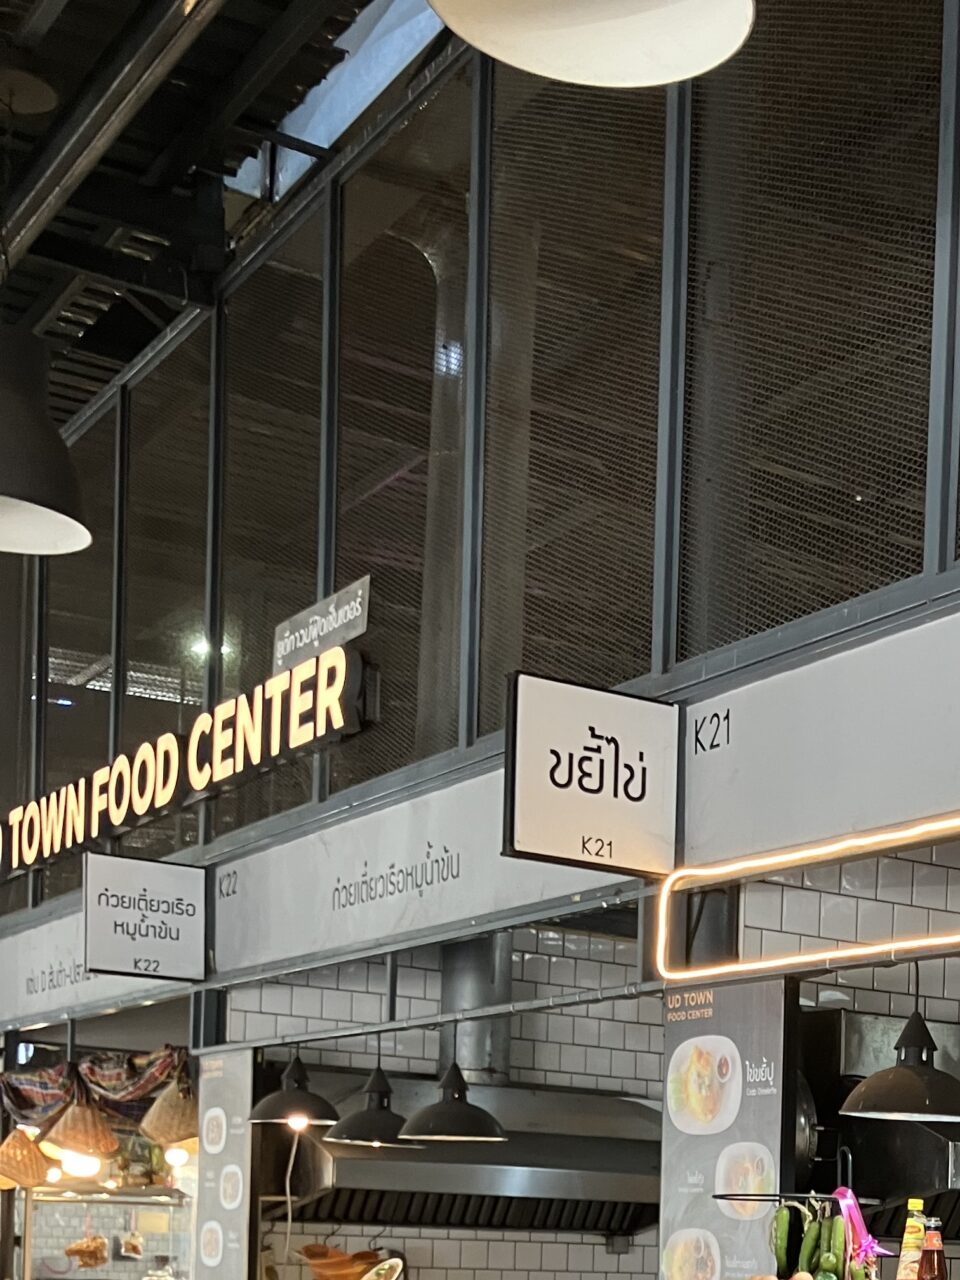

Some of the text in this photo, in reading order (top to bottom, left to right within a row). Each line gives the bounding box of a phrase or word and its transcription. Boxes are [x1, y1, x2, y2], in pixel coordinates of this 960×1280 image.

[694, 708, 731, 755] K21
[8, 777, 86, 869] TOWN
[91, 733, 179, 838] FOOD
[188, 645, 346, 792] CENTER
[549, 726, 647, 802] ขยี้ไข่
[582, 835, 613, 859] K21
[218, 871, 238, 899] K22
[133, 957, 160, 973] K22
[667, 990, 713, 1009] UD TOWN
[667, 1008, 713, 1021] FOOD CENTER
